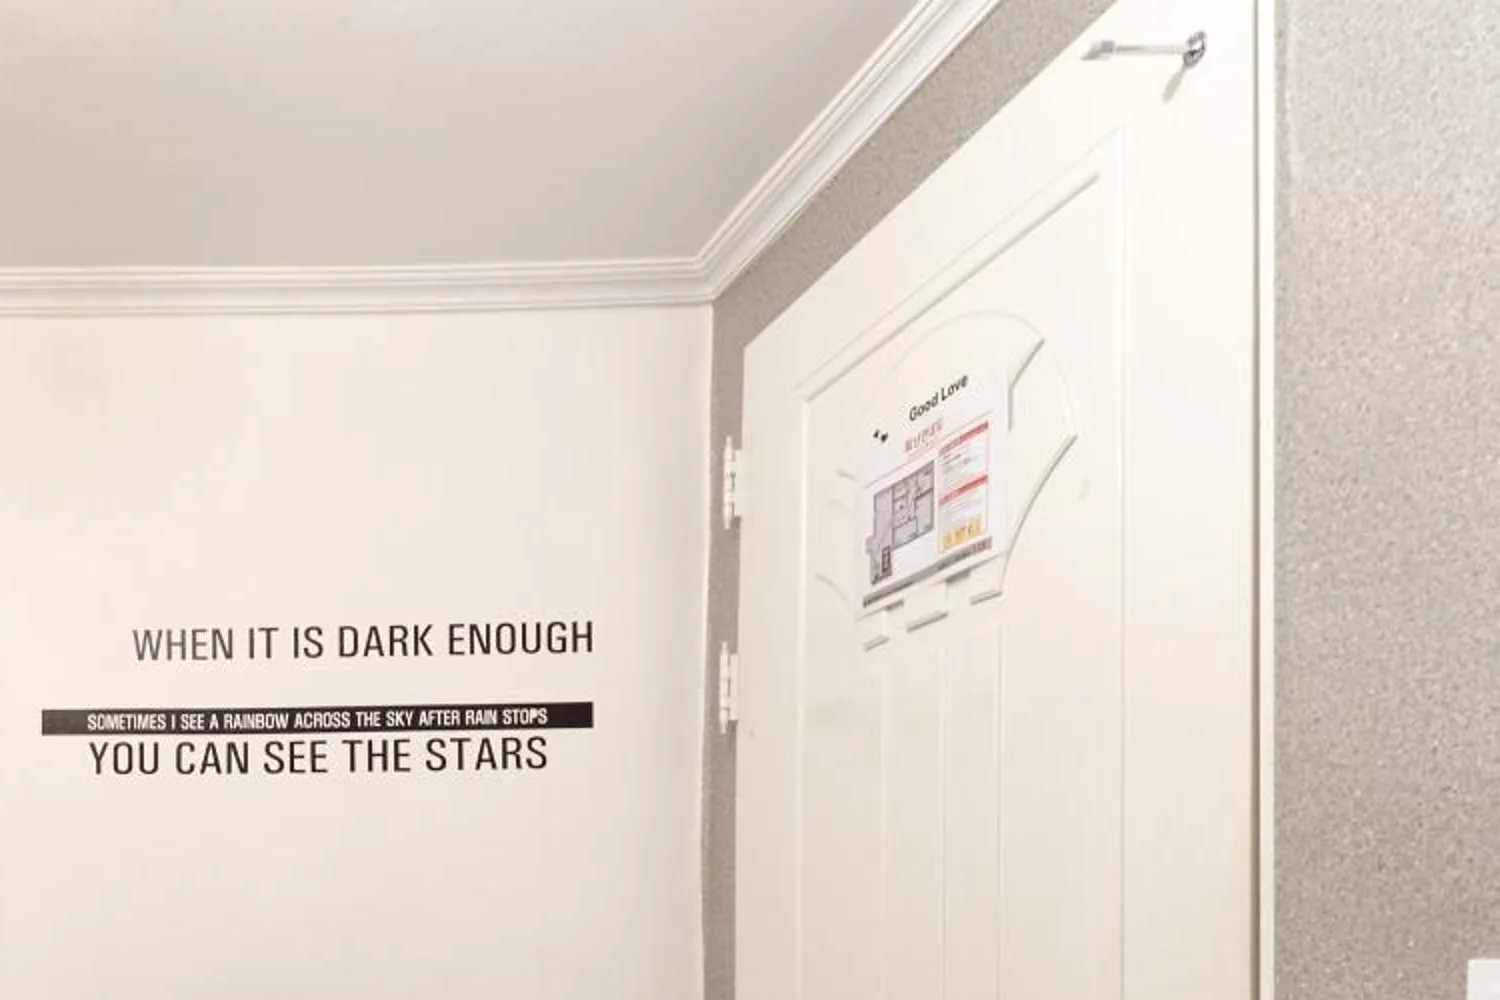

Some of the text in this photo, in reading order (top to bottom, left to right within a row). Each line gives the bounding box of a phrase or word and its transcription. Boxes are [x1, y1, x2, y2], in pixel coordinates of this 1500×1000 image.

[909, 374, 968, 422] Good Love
[132, 620, 594, 661] WHEN IT IS DARK ENOUGH
[87, 708, 548, 731] SOMETIMES I SEE A RAINBOW ACROSS THE SKY AFTER RAIN STOPS
[89, 735, 548, 775] YOU CAN SEE THE STARS
